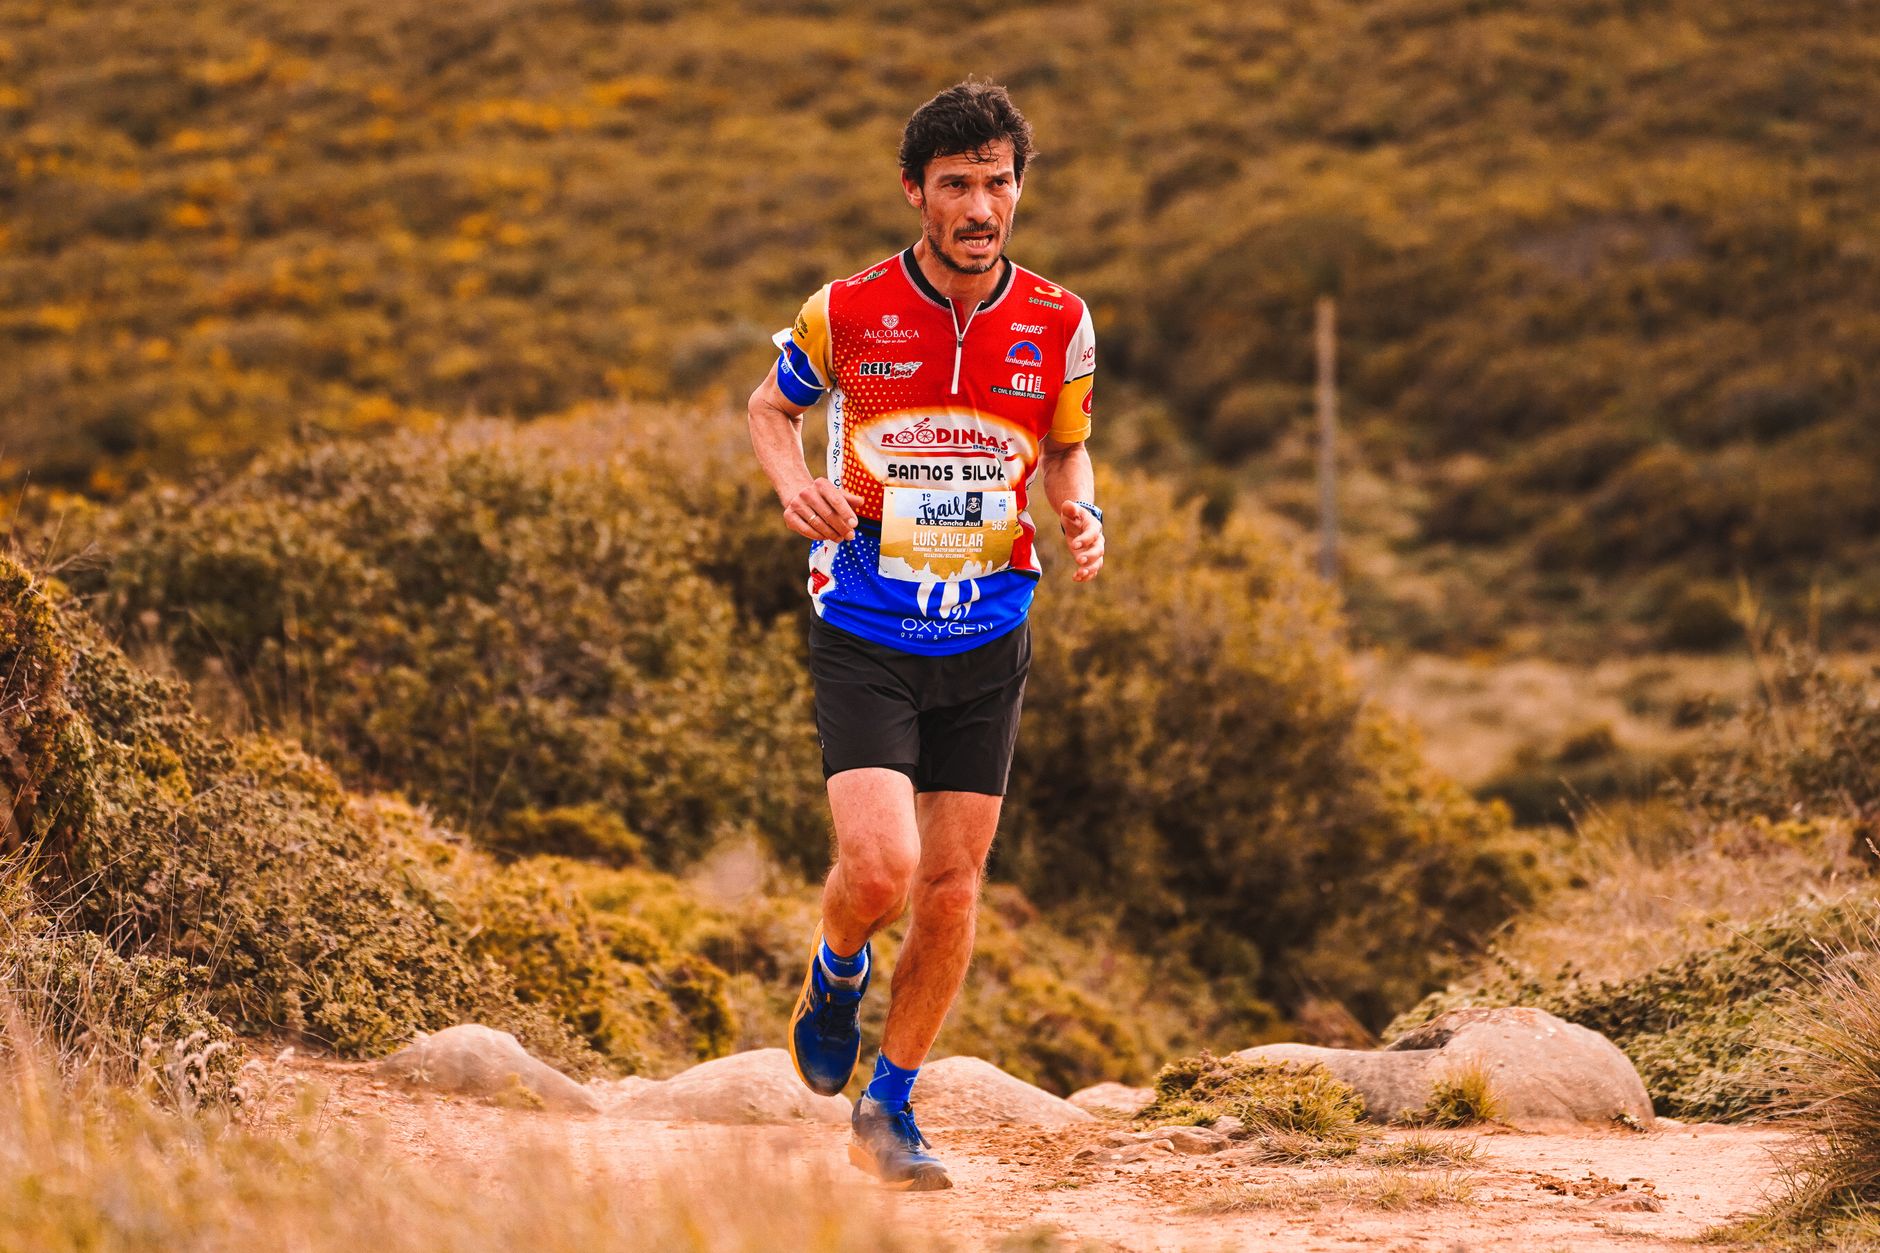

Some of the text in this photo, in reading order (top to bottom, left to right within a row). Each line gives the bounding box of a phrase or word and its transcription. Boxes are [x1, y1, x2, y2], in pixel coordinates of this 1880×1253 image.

[1028, 296, 1064, 311] sermar
[863, 329, 920, 339] ALCOBAÇA
[1010, 322, 1044, 335] COFIDES
[860, 362, 891, 375] REIS
[887, 464, 1005, 481] SANTOS SILVA
[919, 496, 964, 519] Trail
[992, 521, 1007, 531] 562
[913, 531, 984, 547] LUÍS AVELAR
[902, 618, 993, 635] OXYGEN
[901, 632, 924, 640] gym
